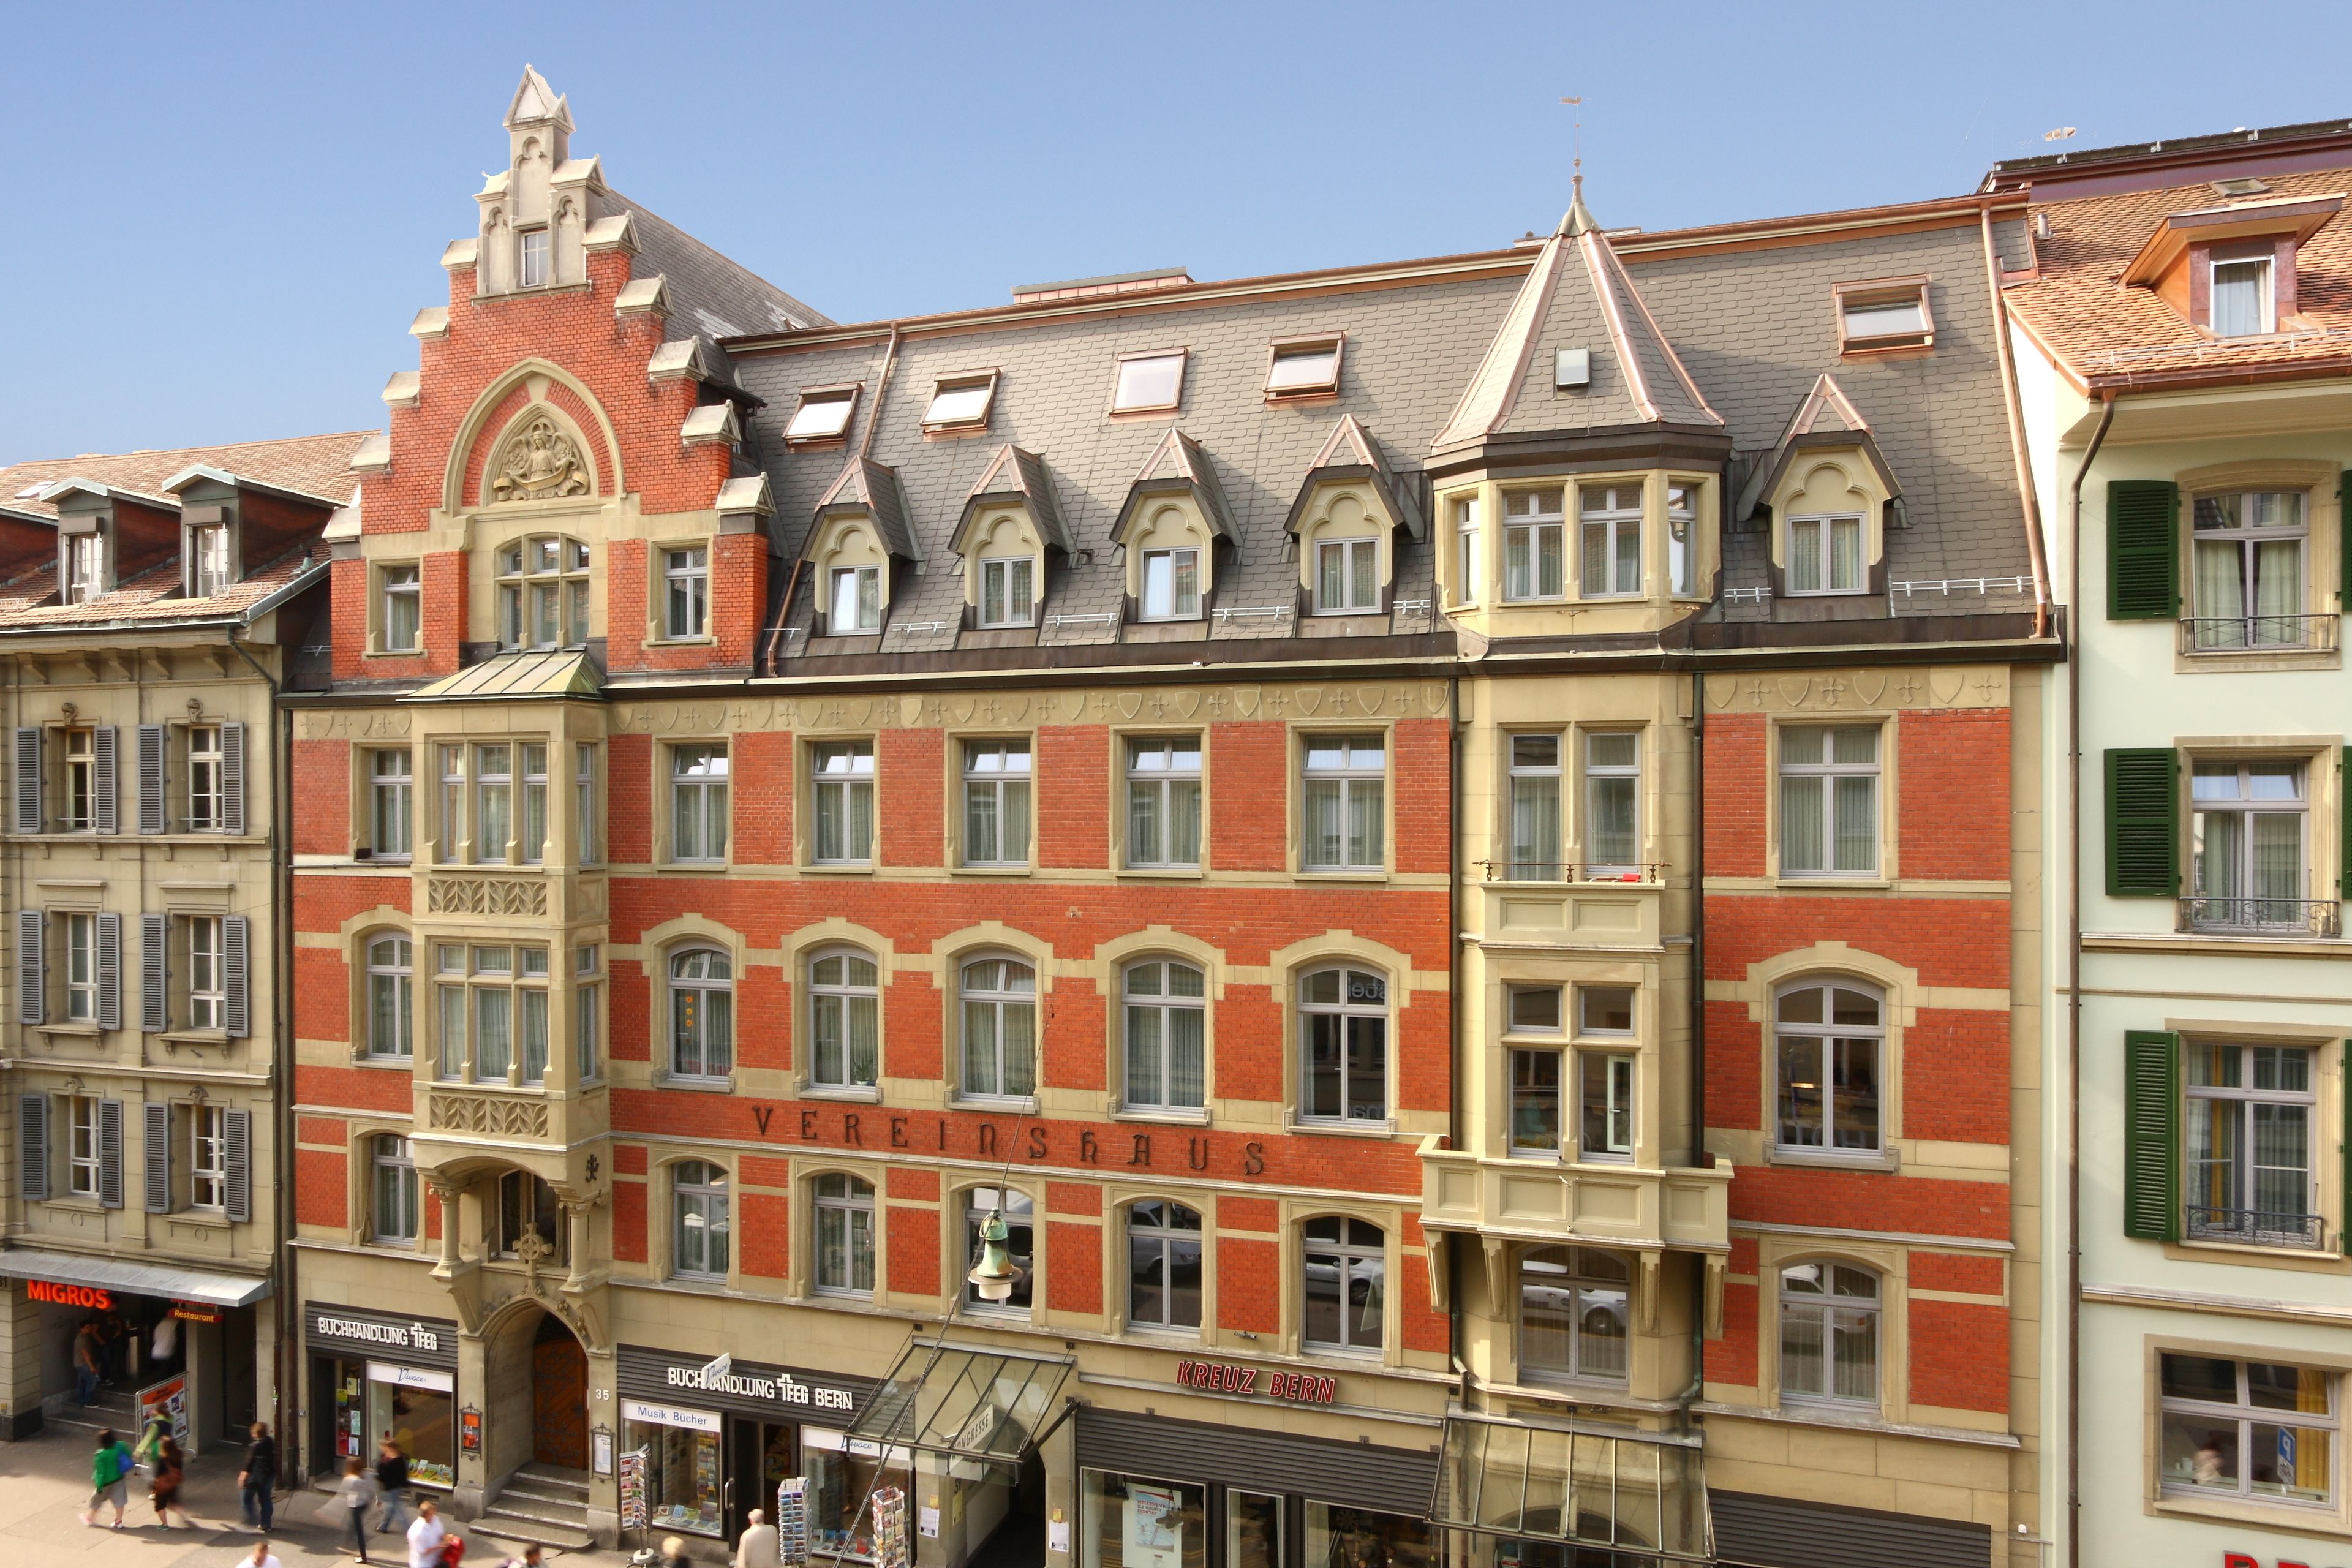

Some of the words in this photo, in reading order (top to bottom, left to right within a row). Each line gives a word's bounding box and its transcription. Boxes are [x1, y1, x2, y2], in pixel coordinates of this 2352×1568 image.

[752, 1105, 1264, 1175] VEREINSHAUS
[28, 1279, 111, 1310] MIGROS
[174, 1310, 214, 1322] Restaurant
[318, 1317, 409, 1346] BUCHHANDLUNG
[397, 1366, 424, 1382] Vivace
[668, 1366, 775, 1400] BUCHANDLUNG
[815, 1387, 853, 1411] BERN
[1176, 1360, 1257, 1394] KREUZ
[1269, 1371, 1336, 1404] BERN
[595, 1389, 609, 1401] 35
[638, 1406, 666, 1420] Musik
[673, 1411, 707, 1425] Bücher
[952, 1413, 989, 1461] NGRESSE
